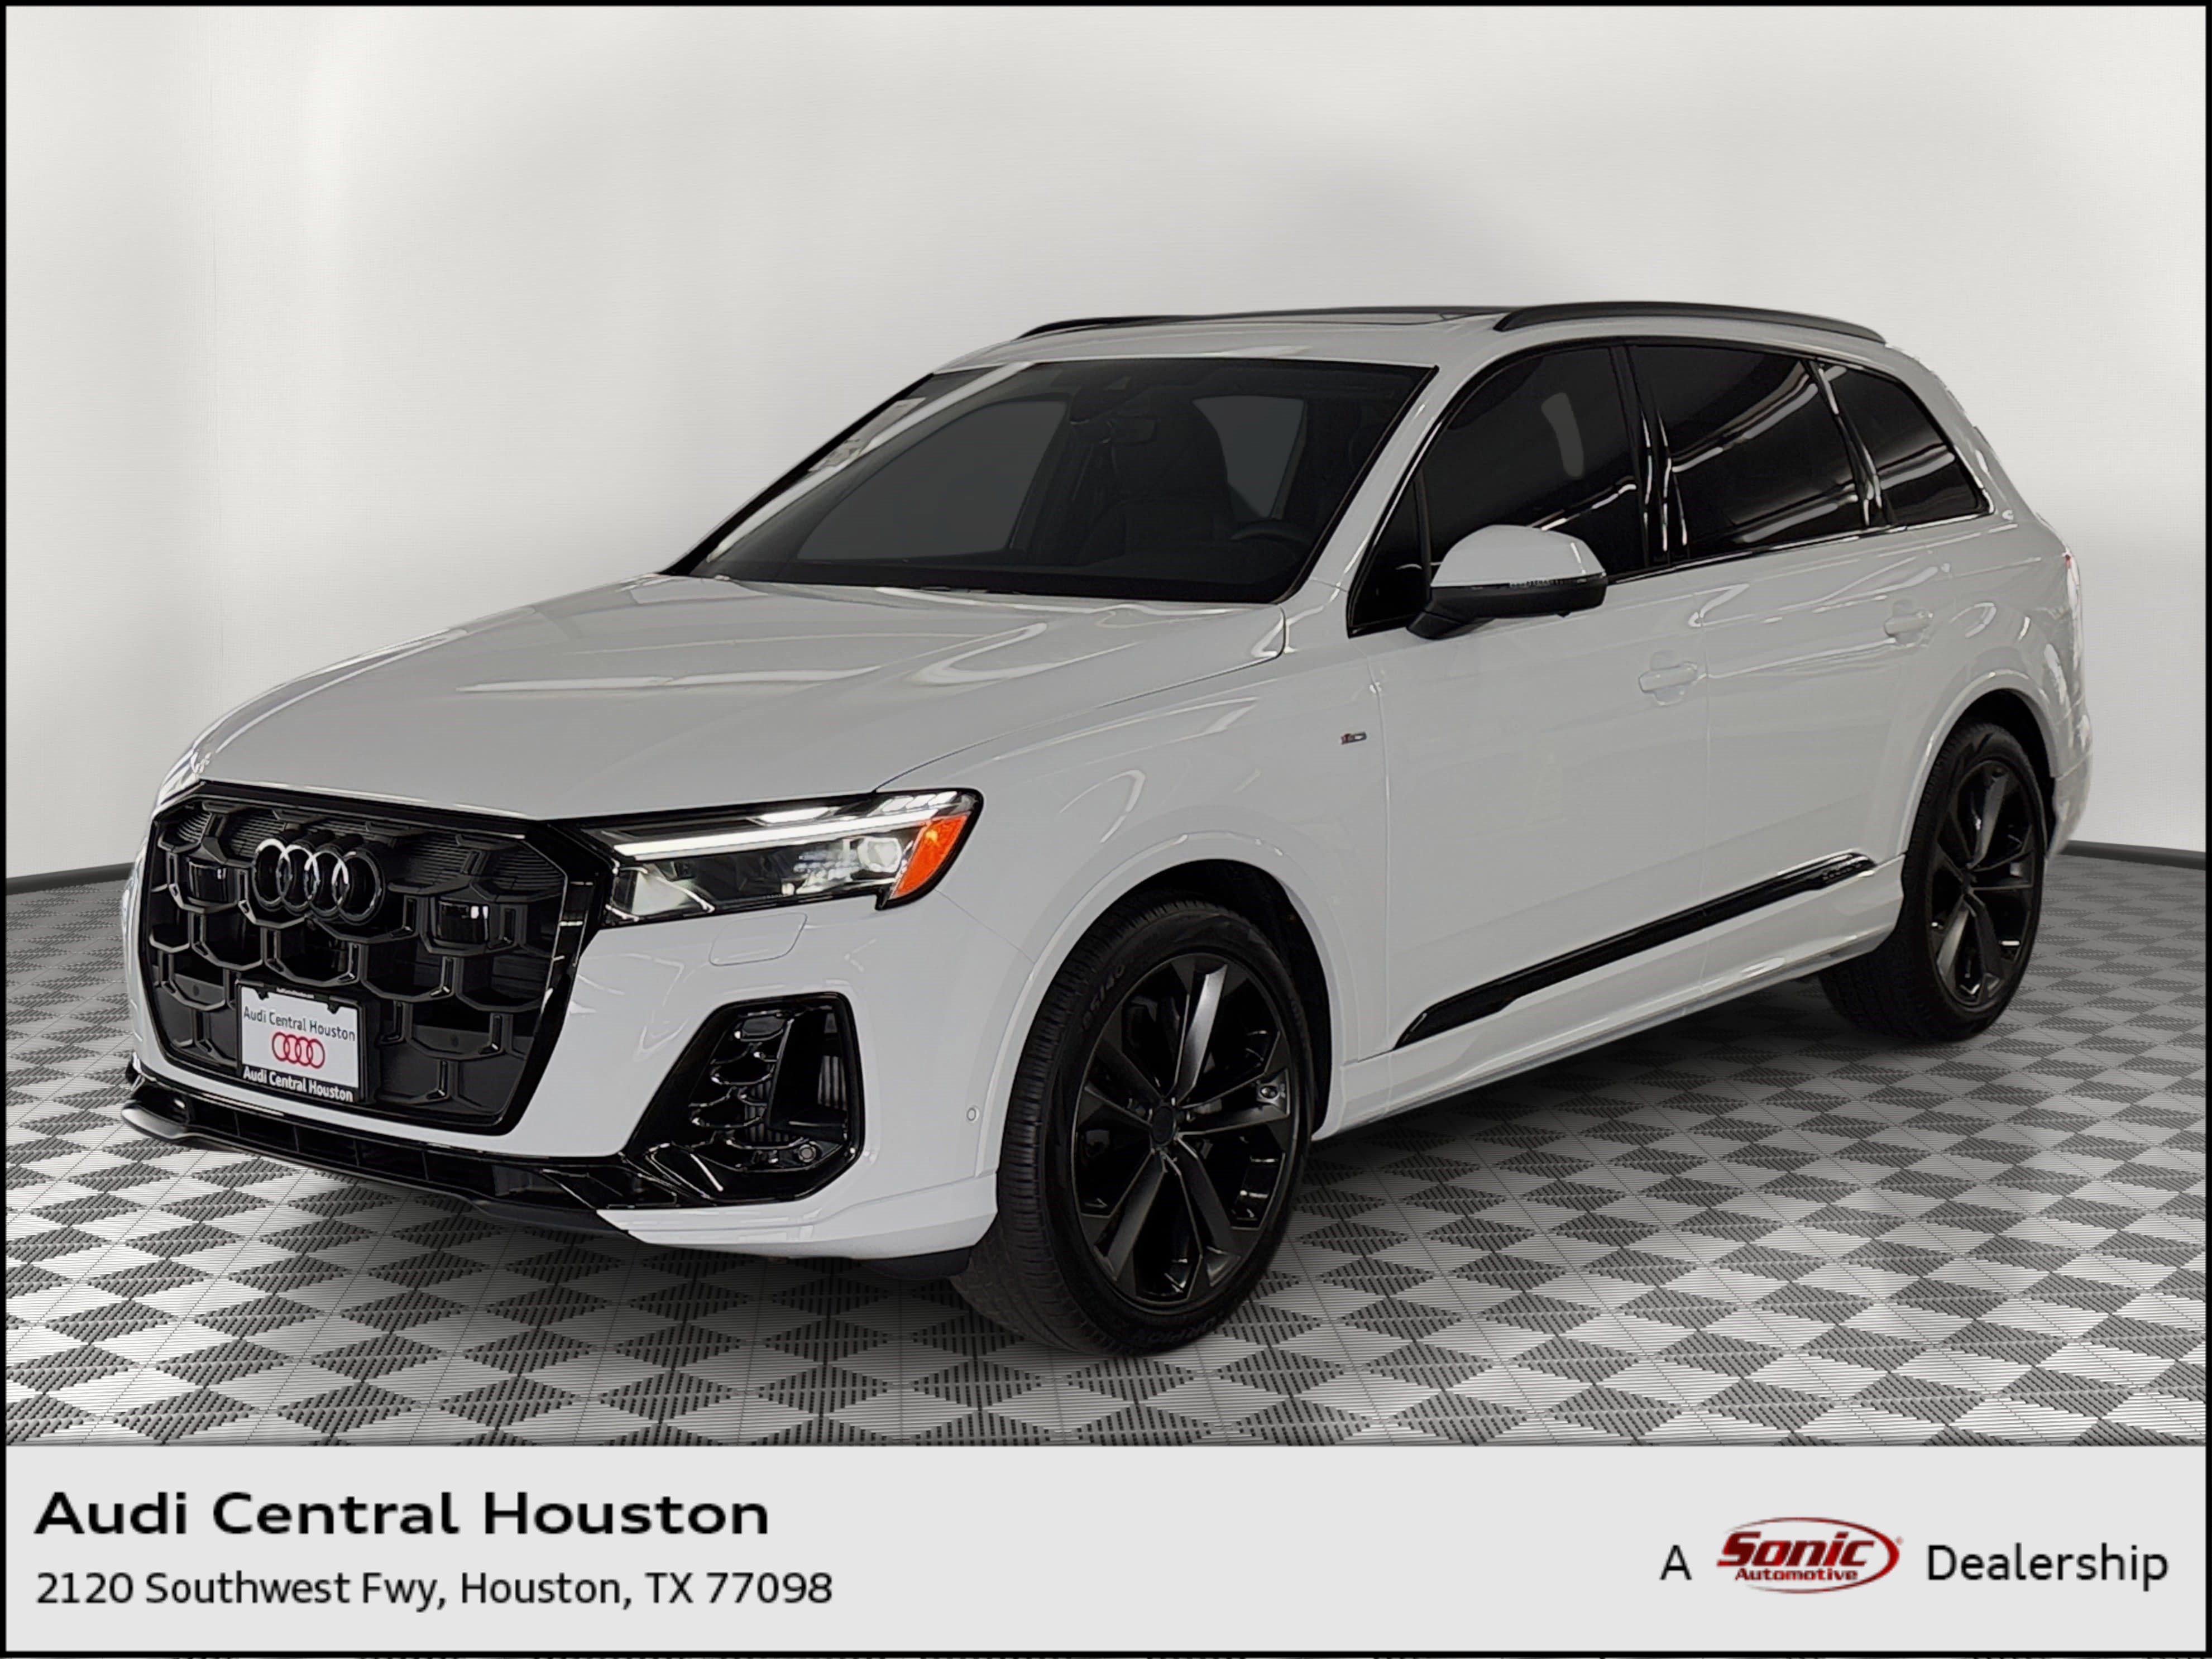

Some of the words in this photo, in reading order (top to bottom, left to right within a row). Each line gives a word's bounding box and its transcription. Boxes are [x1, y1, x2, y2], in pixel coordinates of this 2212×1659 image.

[244, 1006, 266, 1023] Audi
[269, 1012, 306, 1031] Central
[310, 1020, 355, 1041] Houston
[243, 1066, 267, 1082] Audi
[269, 1072, 307, 1092] Central
[308, 1080, 353, 1102] Houston
